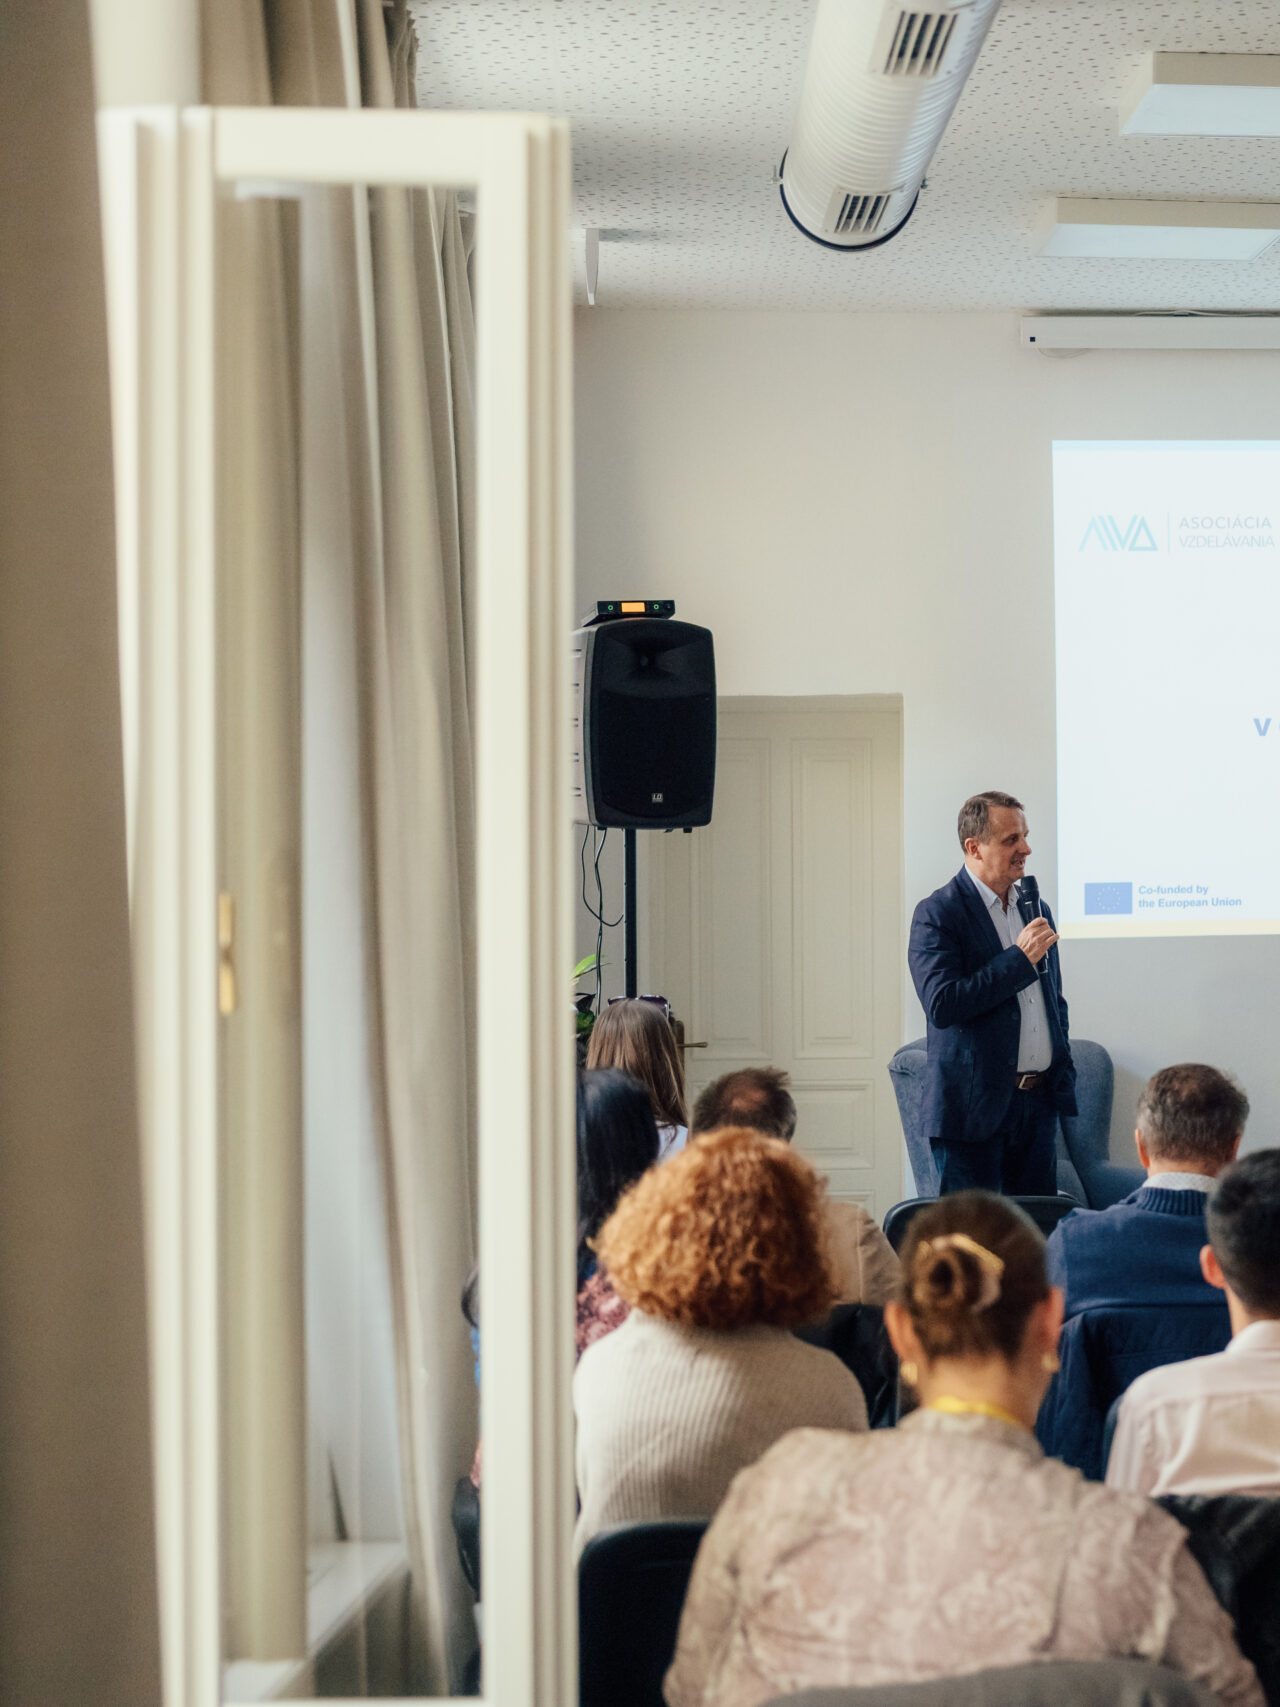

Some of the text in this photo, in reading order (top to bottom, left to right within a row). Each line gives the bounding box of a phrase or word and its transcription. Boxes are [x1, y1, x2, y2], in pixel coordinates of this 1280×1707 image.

[1178, 513, 1272, 529] ASOCIÁCIA
[1178, 531, 1275, 548] VZDELÁVANIA
[1253, 716, 1272, 736] v
[1138, 884, 1209, 896] Co-funded by
[1138, 897, 1243, 910] the European Union
